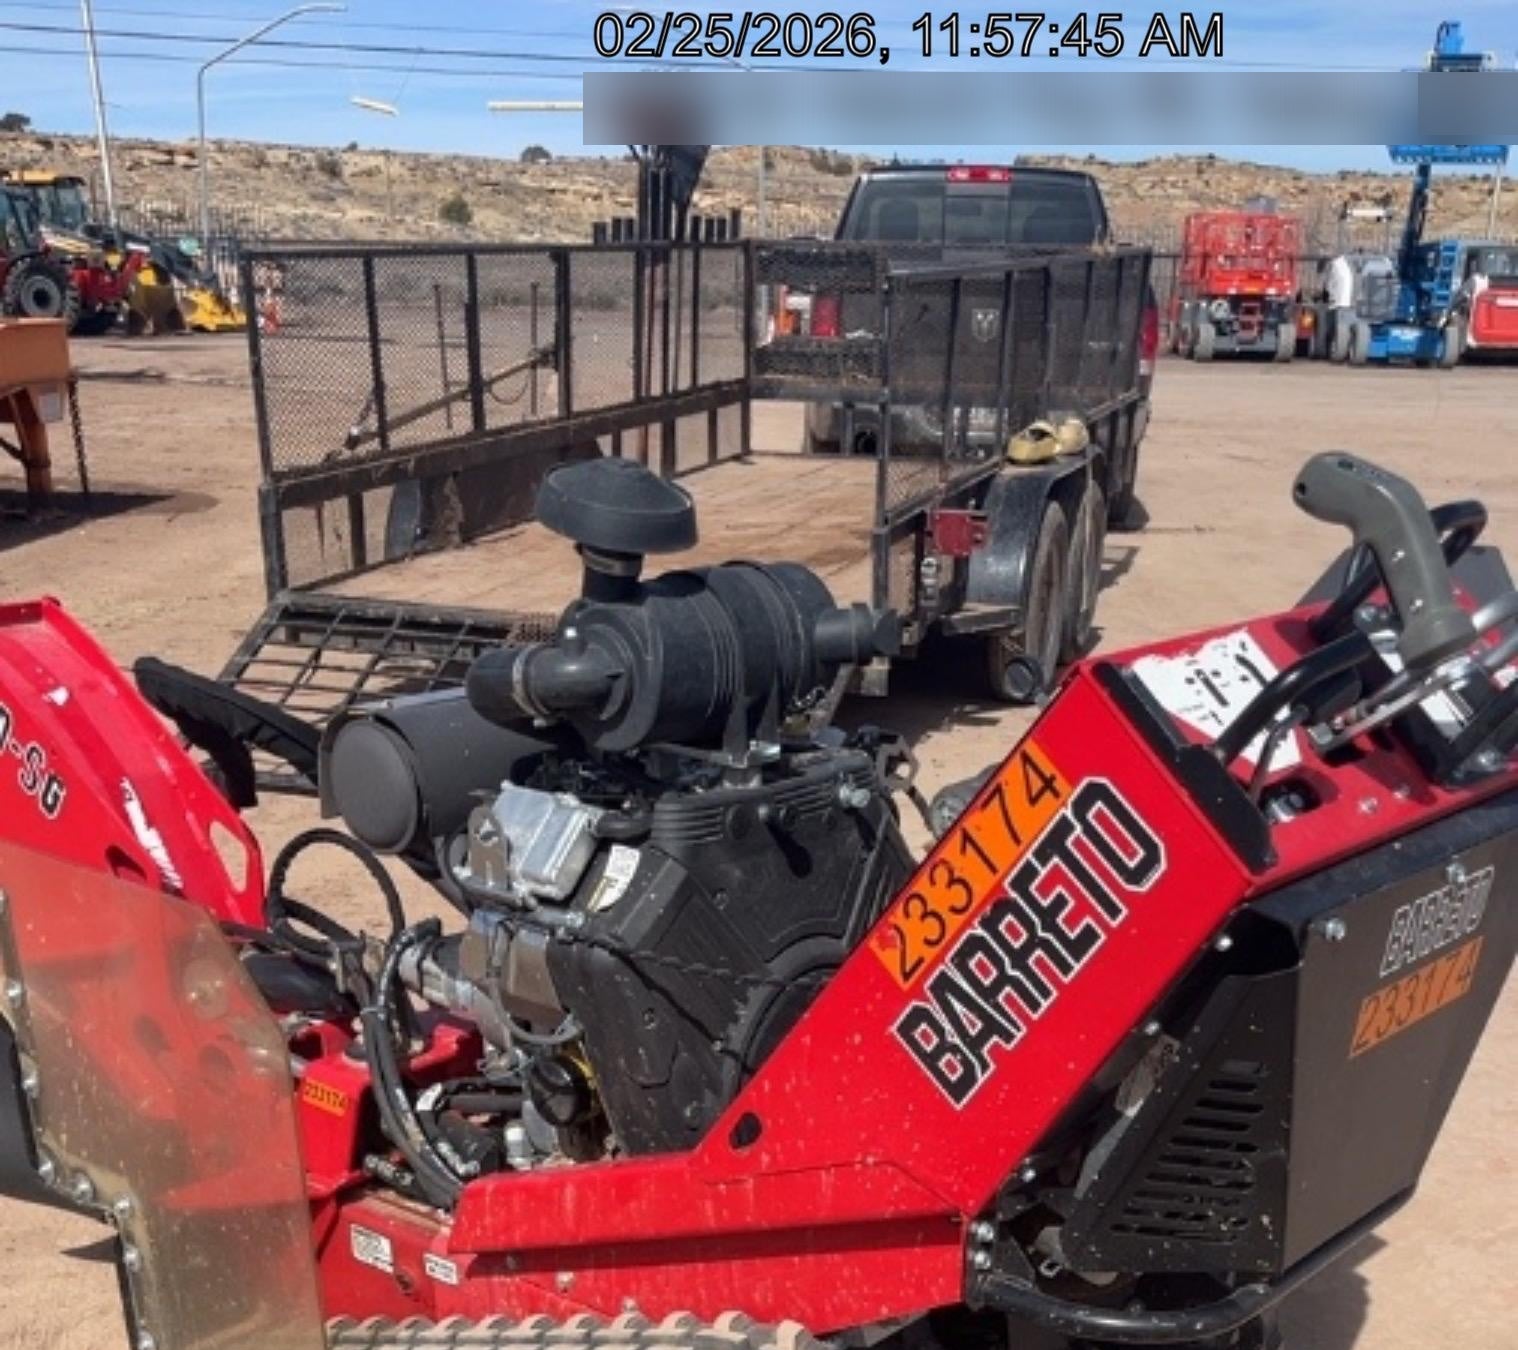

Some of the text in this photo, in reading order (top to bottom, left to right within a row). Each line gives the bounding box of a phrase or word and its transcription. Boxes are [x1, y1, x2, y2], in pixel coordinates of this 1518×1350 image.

[889, 776, 1168, 1111] BARRETO
[893, 749, 1061, 983] 233174
[1354, 944, 1483, 1049] 233174
